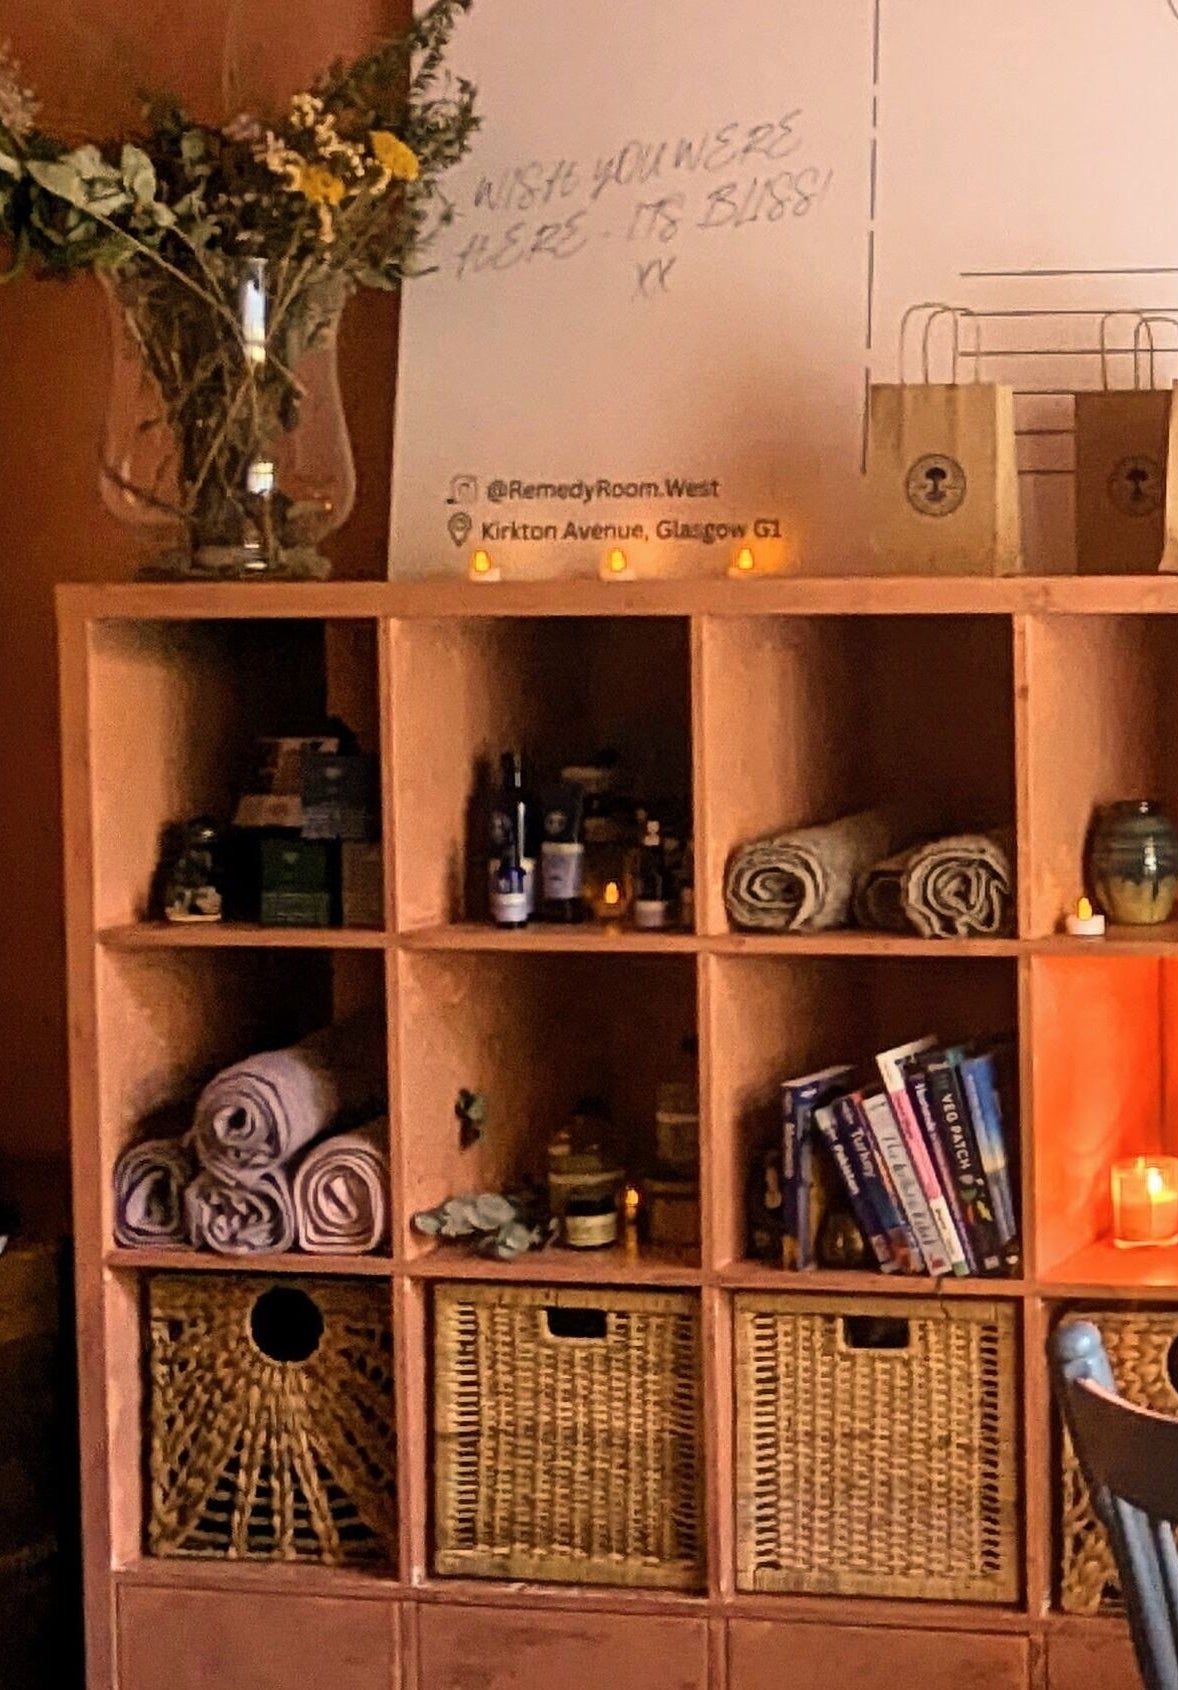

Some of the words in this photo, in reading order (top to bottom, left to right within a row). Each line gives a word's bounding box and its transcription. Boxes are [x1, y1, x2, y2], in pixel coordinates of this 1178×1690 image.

[474, 161, 581, 211] WISH
[590, 139, 669, 200] YOU
[673, 108, 803, 172] WERE
[457, 210, 588, 280] HERE
[487, 479, 720, 504] @RemedyRoom.West
[481, 520, 558, 541] Kirkton
[561, 520, 650, 543] Avenue,
[655, 519, 746, 545] Glasgow
[752, 517, 782, 539] G1
[942, 1093, 960, 1123] VEG
[951, 1125, 972, 1170] PATCH
